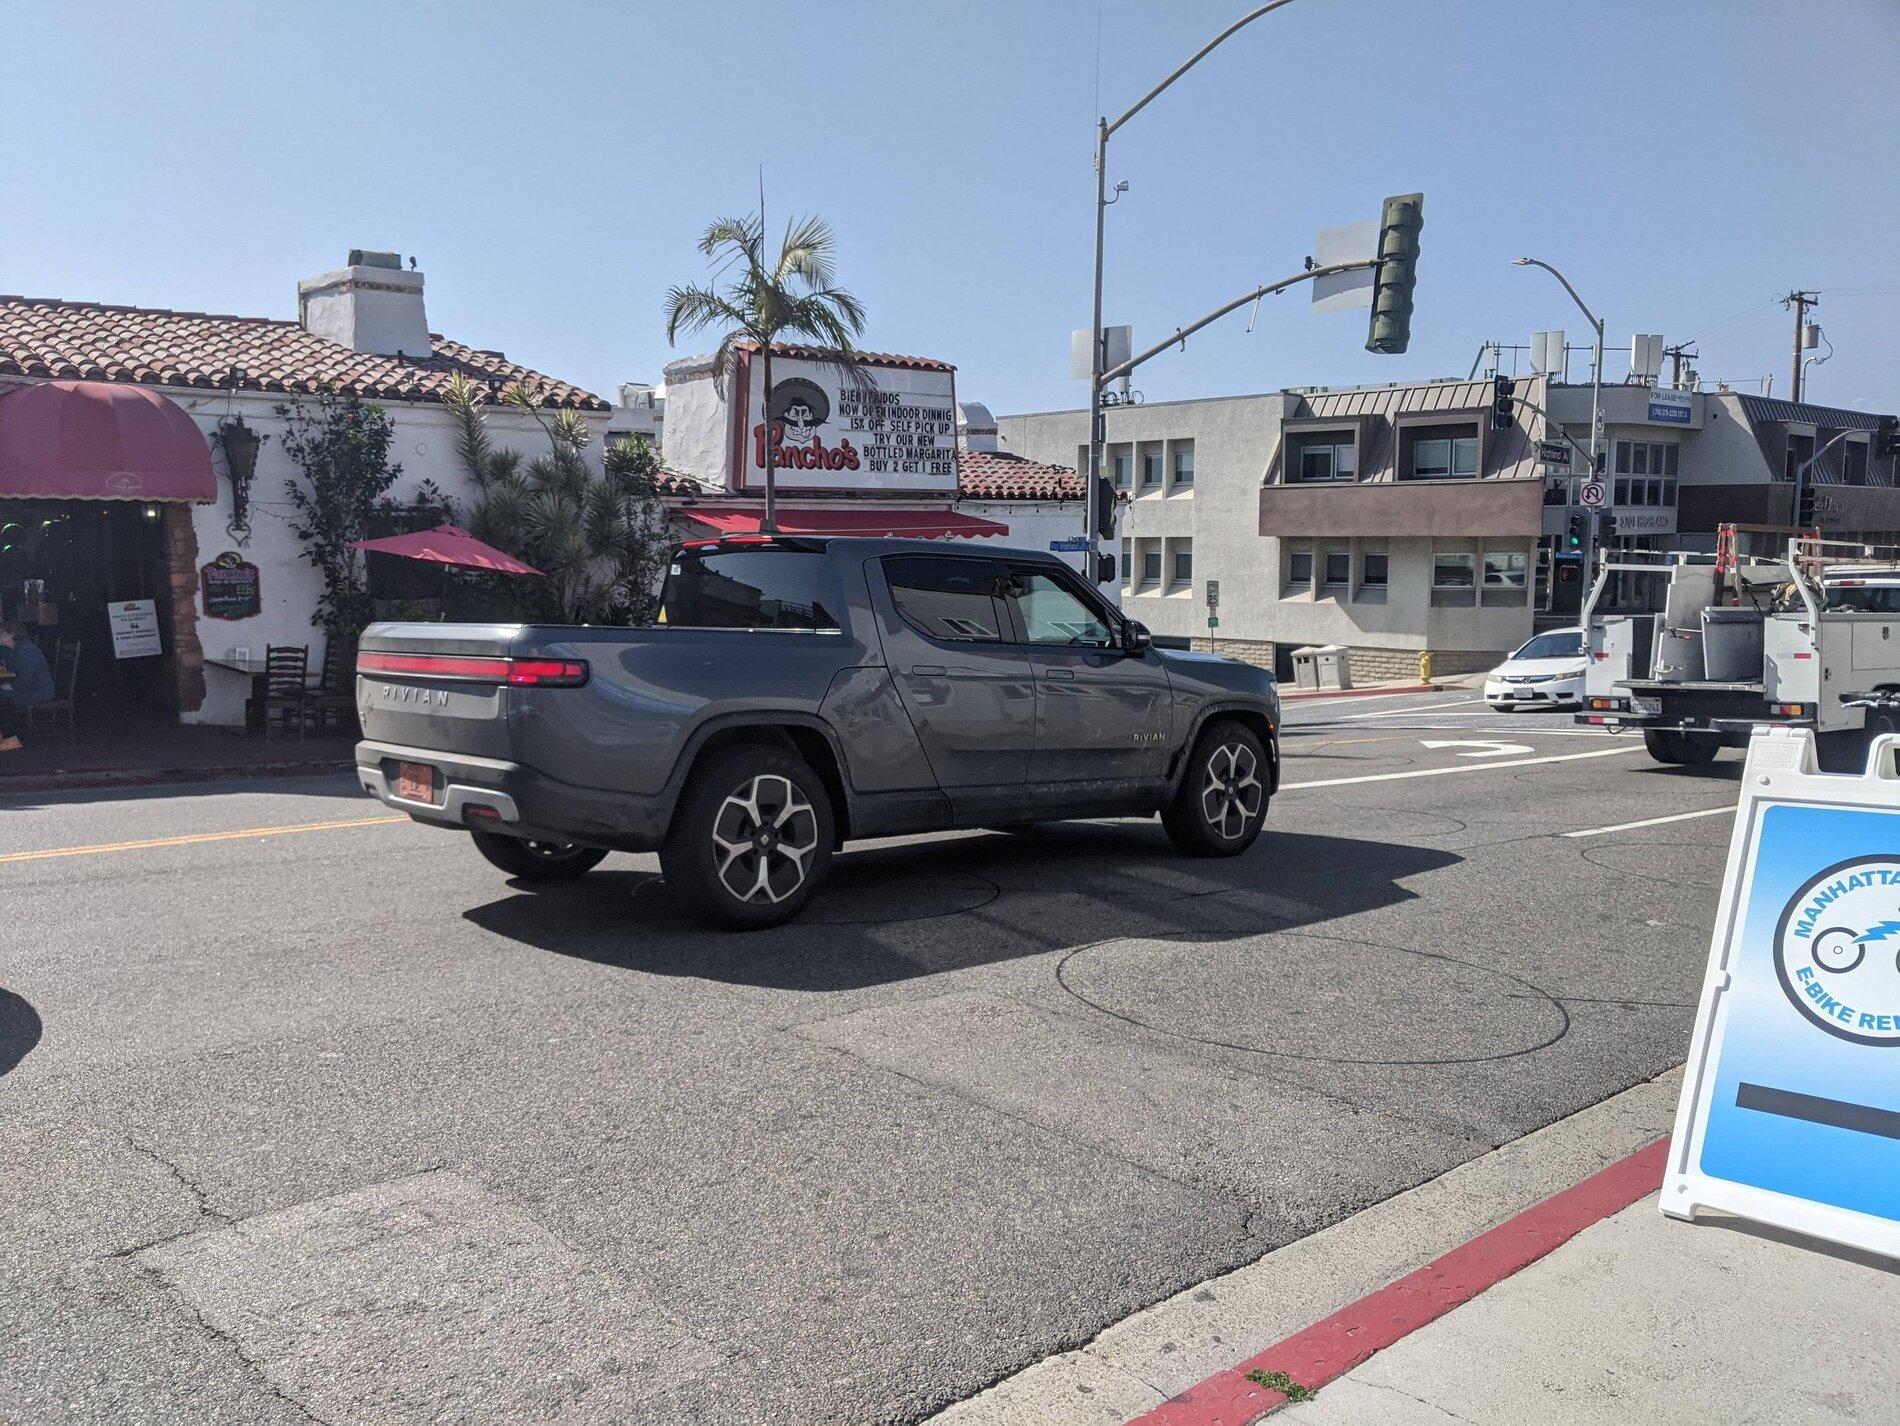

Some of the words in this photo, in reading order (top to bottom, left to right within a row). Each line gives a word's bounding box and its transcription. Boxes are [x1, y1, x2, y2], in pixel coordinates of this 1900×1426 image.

[1662, 392, 1677, 402] LEASE
[839, 403, 859, 416] NOW
[888, 406, 920, 420] INDOOR
[922, 409, 952, 421] DINNIG
[850, 418, 865, 430] 15%
[868, 419, 885, 431] OFF
[890, 420, 912, 433] SELF
[915, 422, 935, 433] PICK
[938, 423, 950, 434] UP
[873, 433, 891, 445] TRY
[896, 434, 913, 446] OUR
[917, 435, 935, 447] NEW
[863, 446, 904, 459] BOTTLED
[906, 448, 956, 460] MARGARITA
[870, 460, 888, 472] BUY
[893, 461, 899, 473] 2
[902, 461, 919, 473] GET
[931, 462, 952, 474] FREE
[1208, 594, 1218, 604] 25
[383, 685, 449, 707] RIVIAN
[1133, 733, 1165, 742] RIVIAN
[1794, 870, 1900, 939] MANHATTA
[1795, 966, 1855, 1024] E-BIKE
